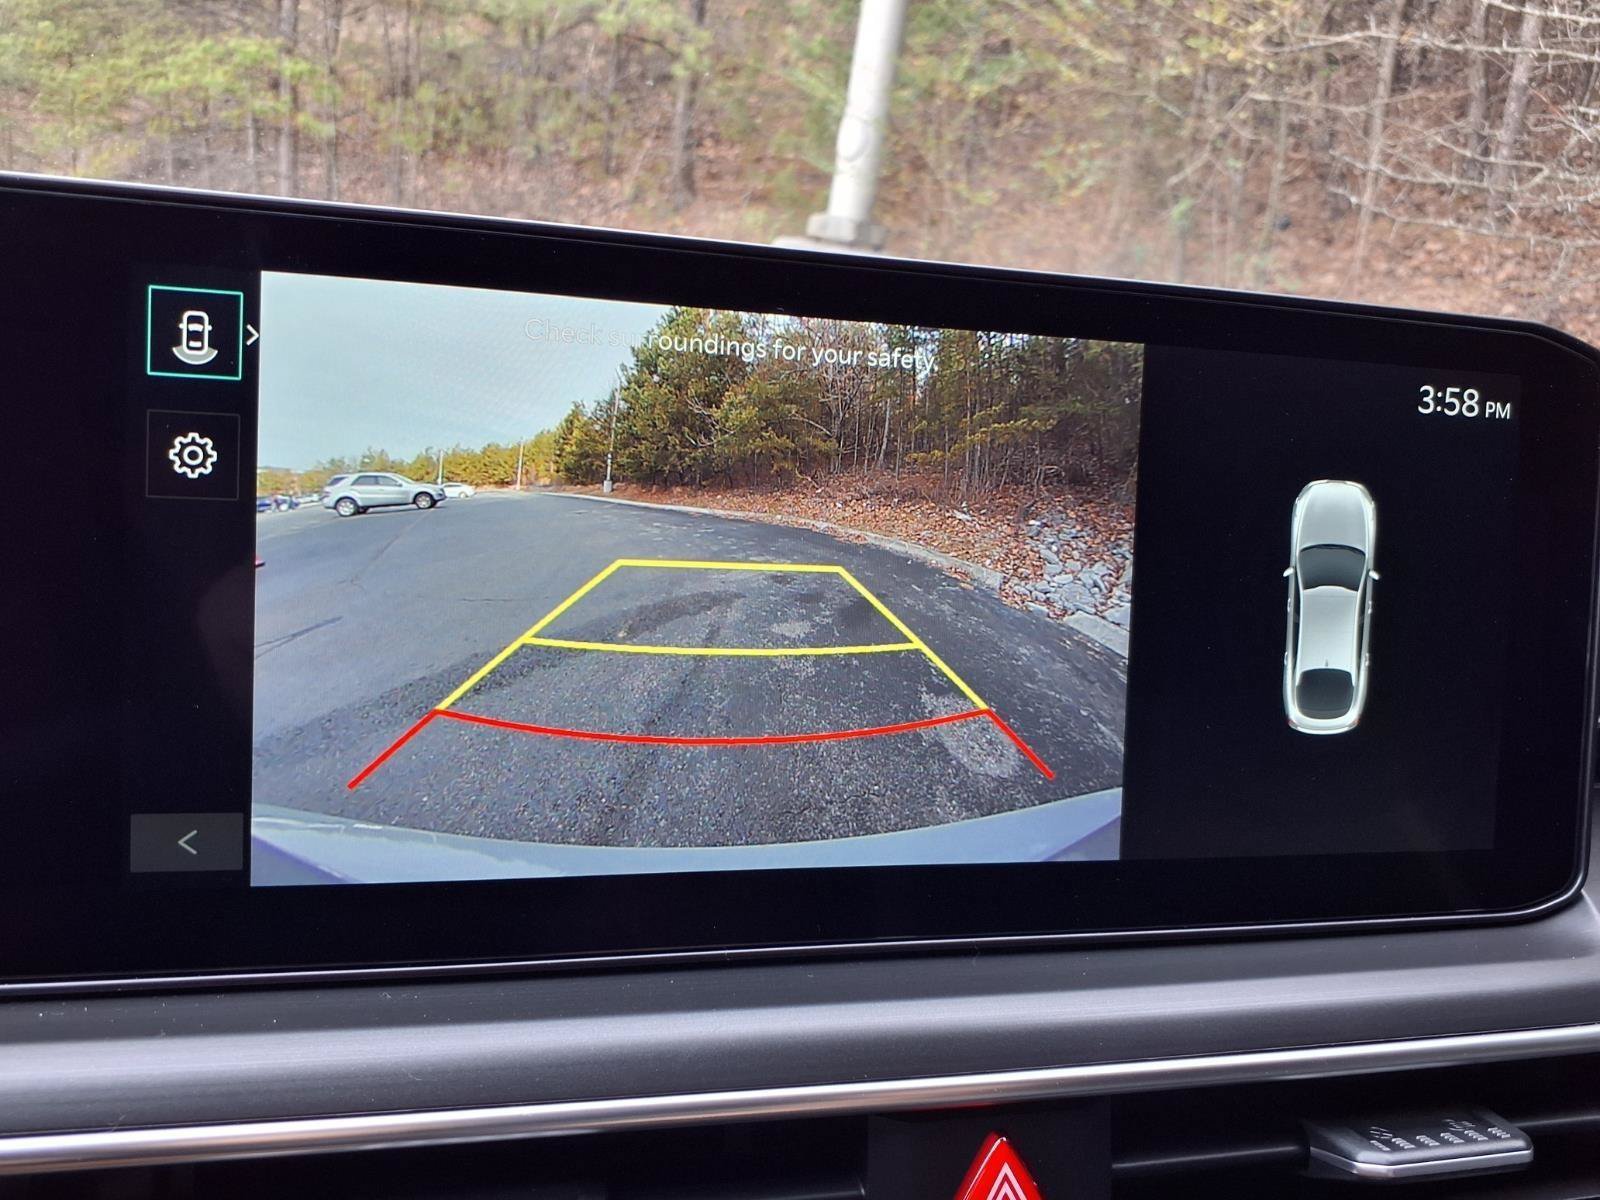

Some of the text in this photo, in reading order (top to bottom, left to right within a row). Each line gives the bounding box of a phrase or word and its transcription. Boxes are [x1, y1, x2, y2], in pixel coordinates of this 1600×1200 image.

[524, 318, 602, 346] Check
[774, 338, 805, 361] for
[812, 346, 863, 367] your
[1418, 384, 1511, 420] 3:58 PM
